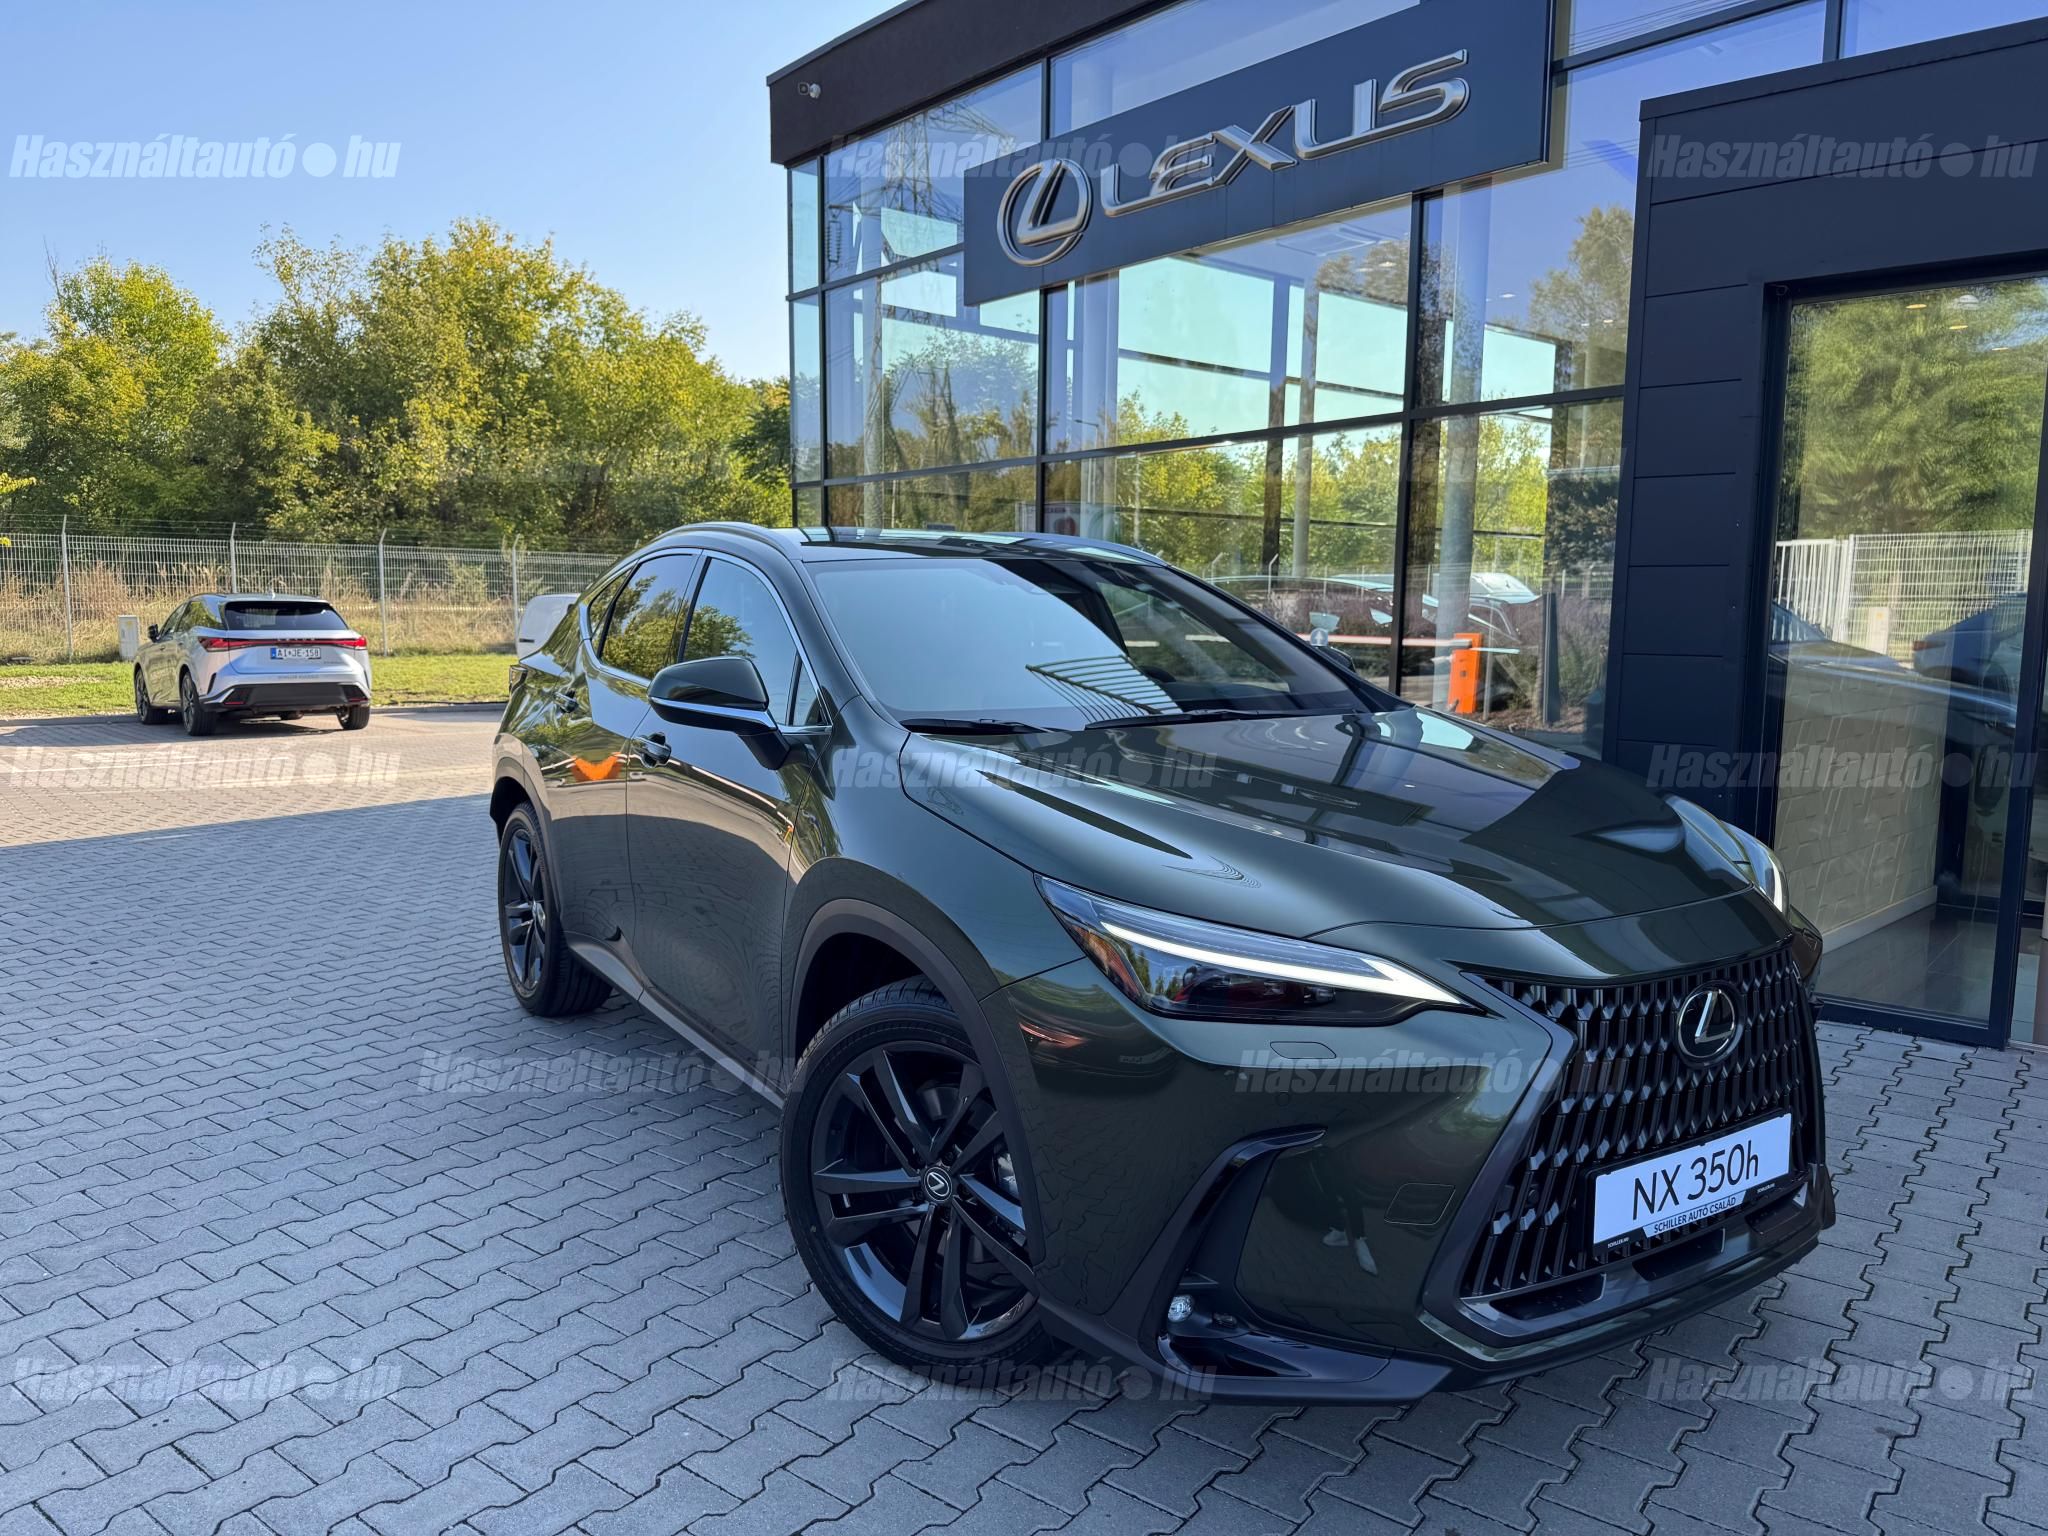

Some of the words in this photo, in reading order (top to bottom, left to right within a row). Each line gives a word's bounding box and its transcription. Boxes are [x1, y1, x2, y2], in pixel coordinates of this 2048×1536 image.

[1101, 48, 1470, 217] LEXUS
[1632, 1164, 1682, 1220] NX
[1687, 1139, 1759, 1201] 350h
[1654, 1214, 1687, 1233] SCHILLER
[1688, 1204, 1709, 1221] AUTÓ
[1710, 1196, 1736, 1214] CSALÁD
